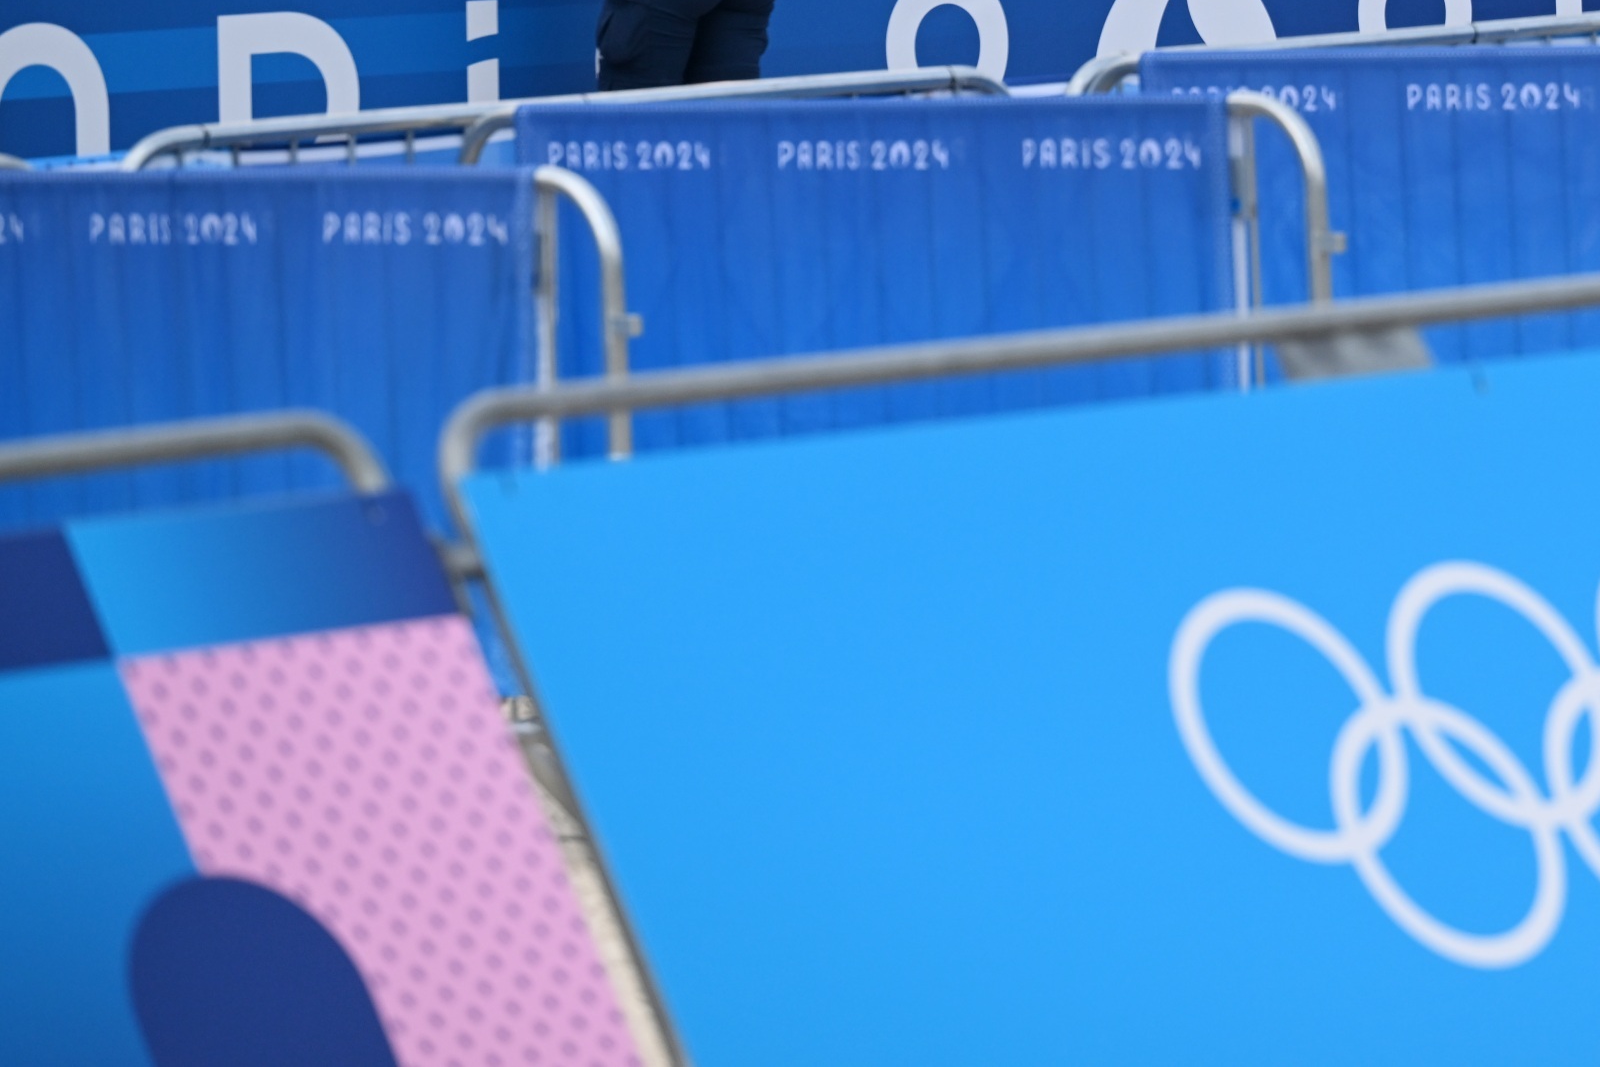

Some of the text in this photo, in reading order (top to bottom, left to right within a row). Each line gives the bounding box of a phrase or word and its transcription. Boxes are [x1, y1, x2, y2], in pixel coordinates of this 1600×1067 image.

[1501, 82, 1581, 111] 2024
[636, 140, 711, 170] 2024
[870, 138, 949, 170] 2024
[1119, 137, 1201, 170] 2024
[184, 211, 258, 245] 2024
[423, 211, 509, 246] 2024
